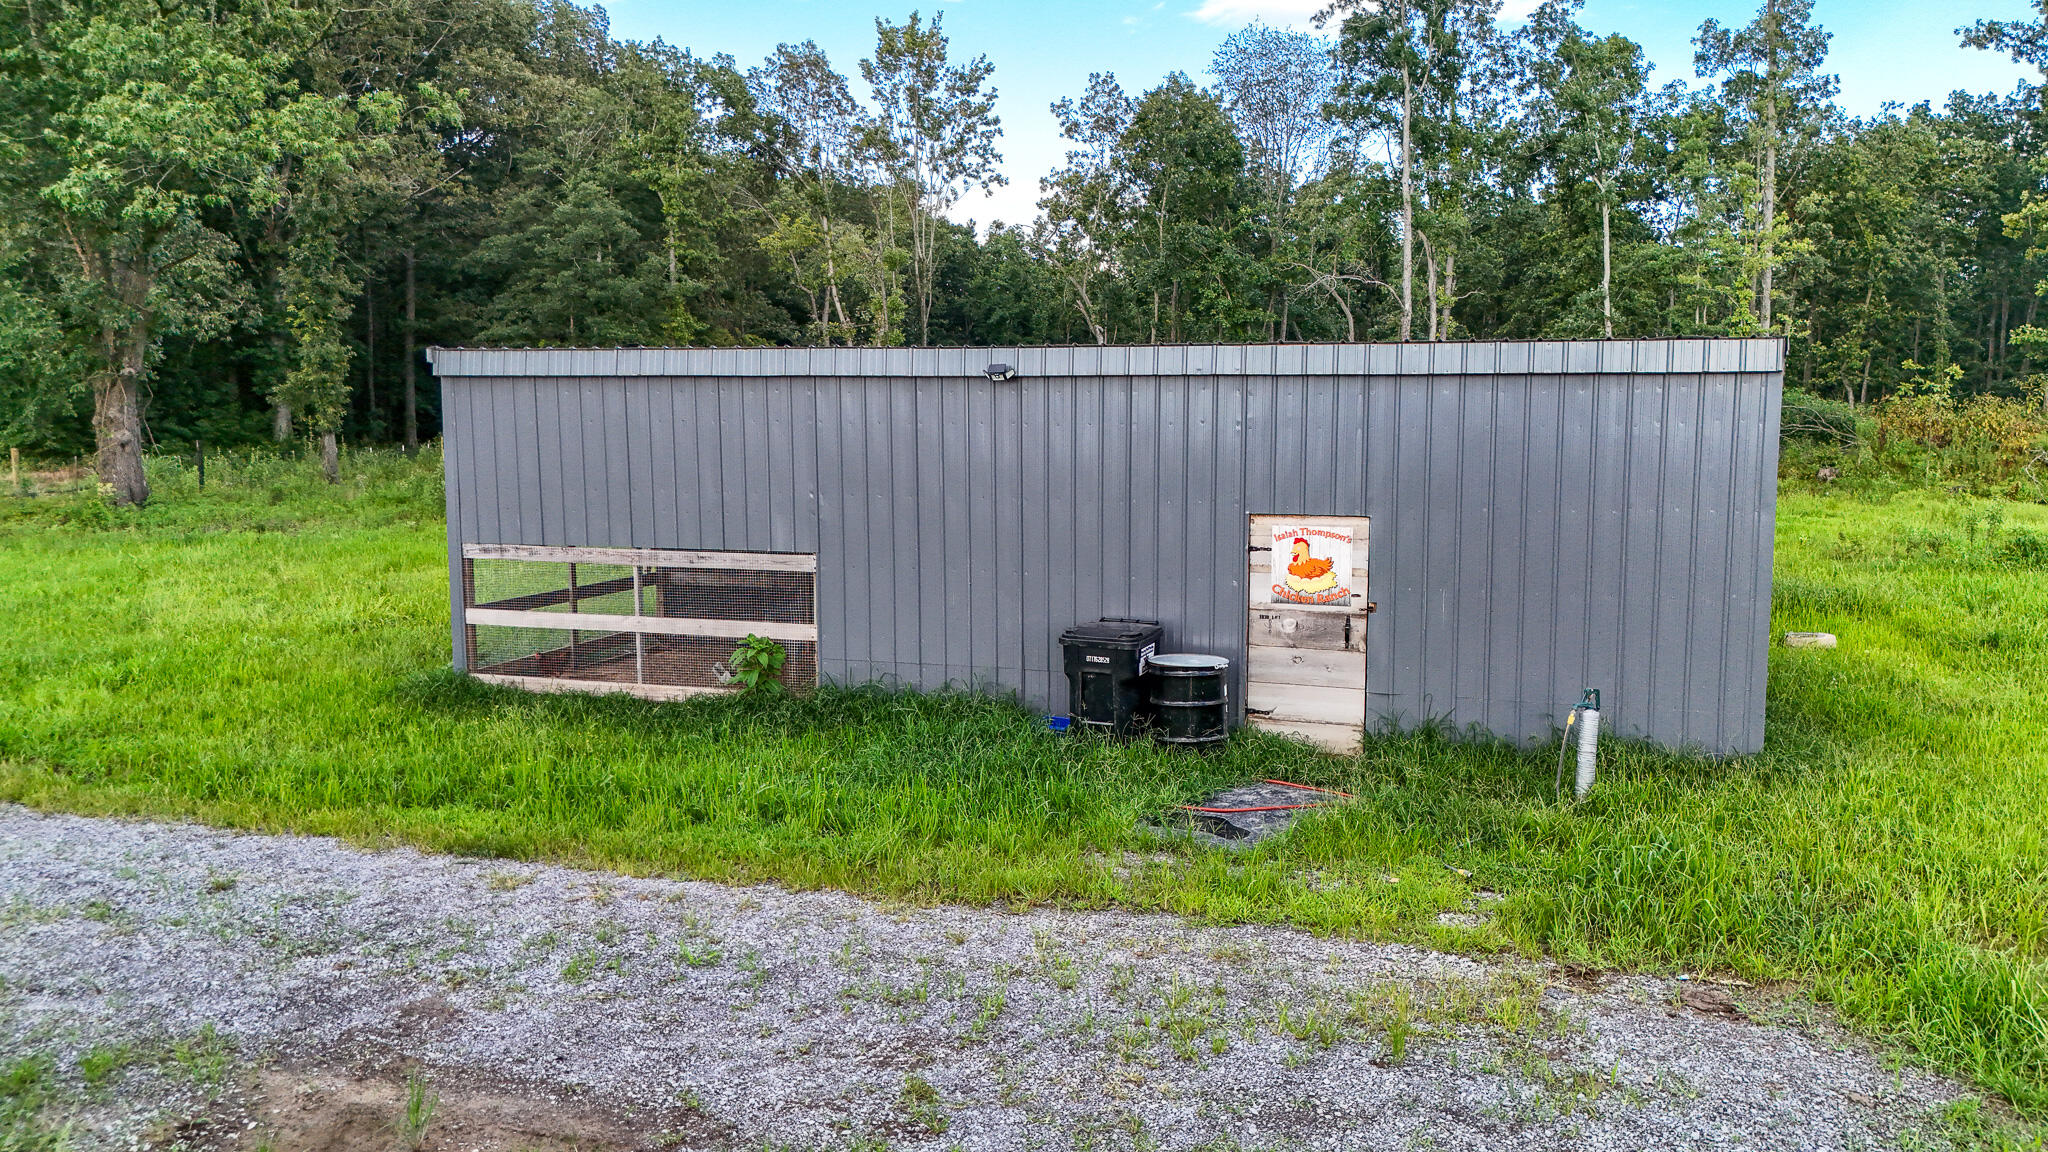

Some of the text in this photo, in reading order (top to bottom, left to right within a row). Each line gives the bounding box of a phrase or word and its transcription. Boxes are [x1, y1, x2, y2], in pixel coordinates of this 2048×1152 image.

[1273, 527, 1353, 544] Isaiah Thompson's
[1272, 584, 1351, 604] Chicken Ranch
